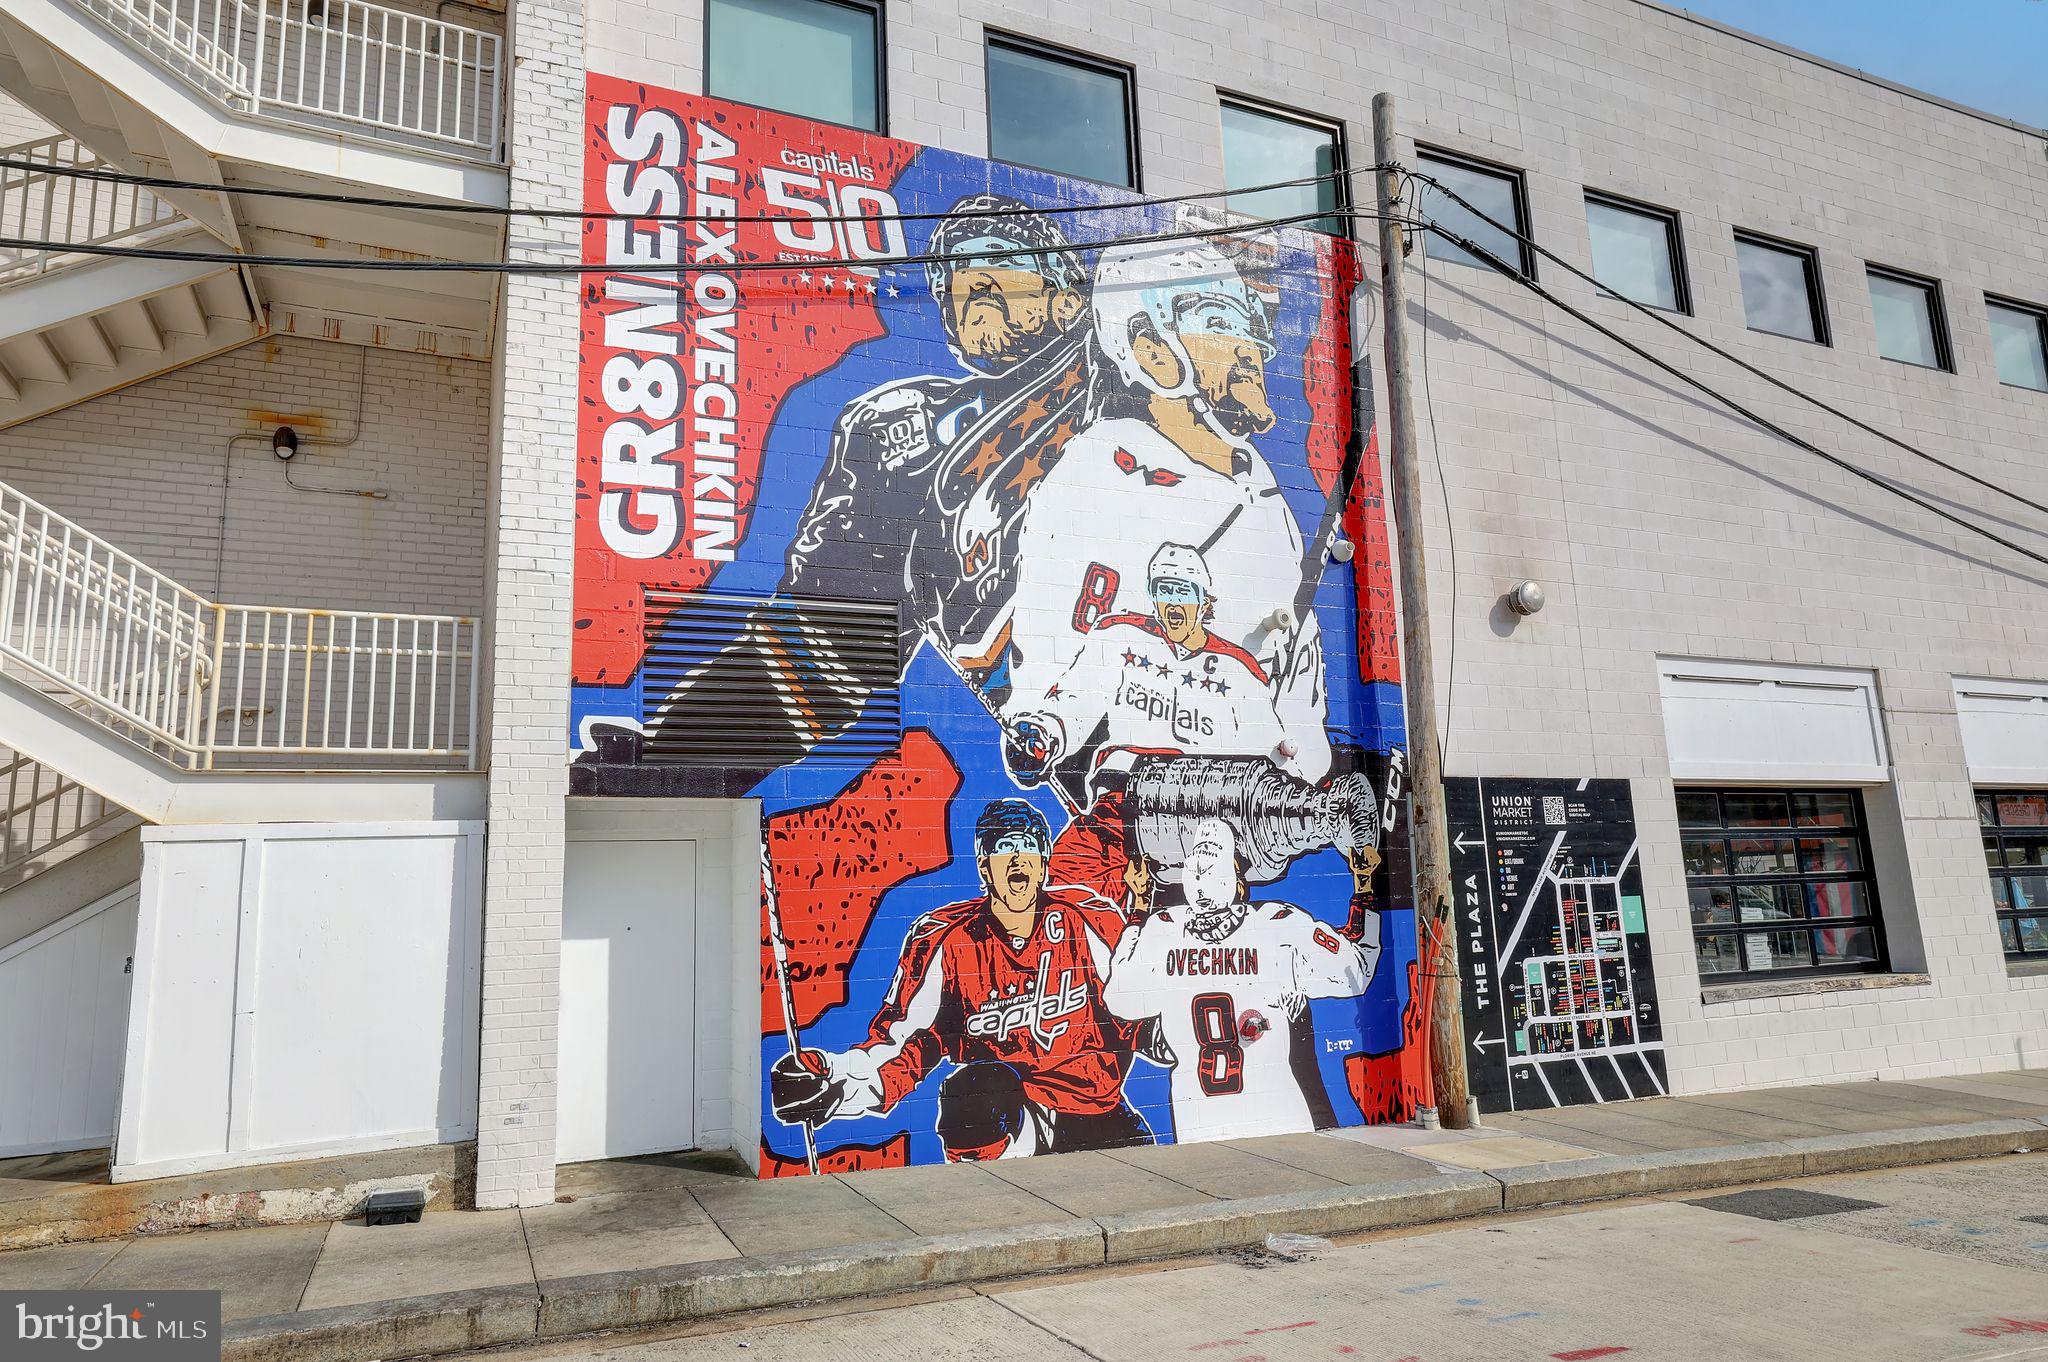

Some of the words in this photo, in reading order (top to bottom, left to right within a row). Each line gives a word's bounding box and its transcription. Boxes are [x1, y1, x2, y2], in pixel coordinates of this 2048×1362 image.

[694, 122, 739, 261] ALEX
[780, 150, 875, 181] capitals
[599, 104, 685, 559] GR8NESS
[693, 272, 739, 561] OVECHKIN
[1071, 561, 1121, 635] 8
[1203, 655, 1218, 675] C
[1125, 687, 1214, 744] capitals
[1491, 796, 1532, 806] UNION
[1493, 807, 1533, 818] MARKET
[1045, 911, 1065, 944] C
[1465, 874, 1485, 953] PLAZA
[1166, 947, 1259, 976] OVECHKIN
[1313, 928, 1340, 954] 8
[967, 950, 1088, 1051] capitals
[1474, 962, 1489, 1010] THE
[1191, 991, 1244, 1097] 8
